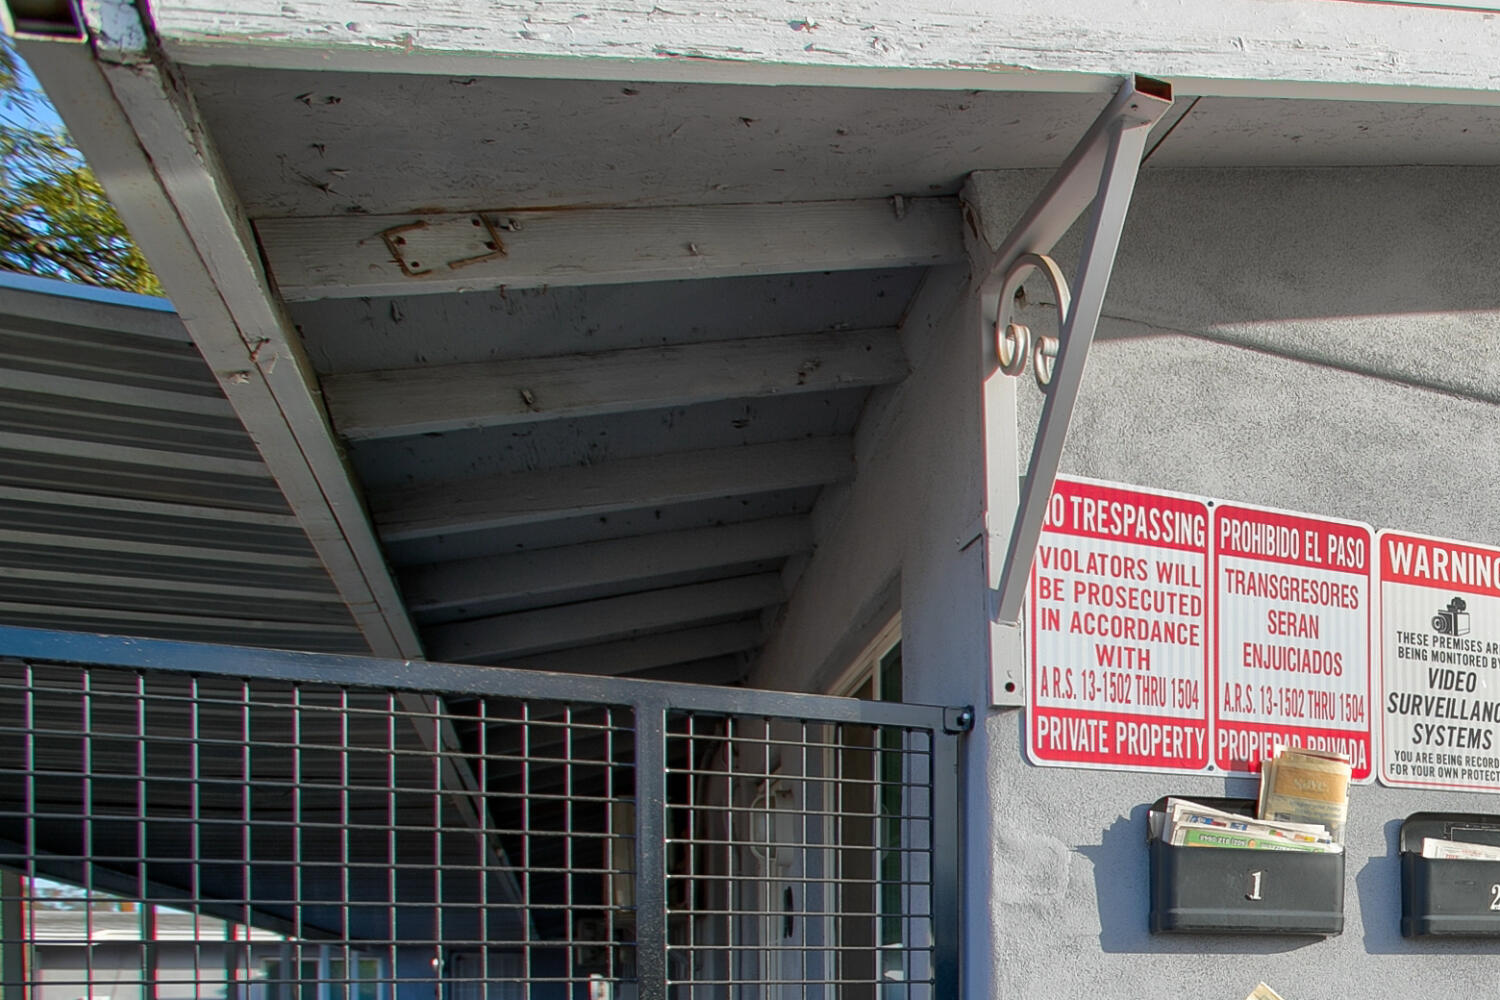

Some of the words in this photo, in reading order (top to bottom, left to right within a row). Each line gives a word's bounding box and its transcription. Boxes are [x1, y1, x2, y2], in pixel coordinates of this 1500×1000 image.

[1070, 495, 1205, 548] TRESPASSING
[1220, 517, 1300, 560] PROHIBIDO
[1305, 531, 1322, 563] EL
[1328, 534, 1364, 569] PASO
[1039, 545, 1148, 581] VIOLATORS
[1156, 560, 1202, 588] WILL
[1039, 576, 1064, 601] BE
[1074, 580, 1202, 617] PROSECUTED
[1225, 568, 1359, 610] TRANSGRESORES
[1041, 607, 1060, 632] IN
[1069, 611, 1200, 646] ACCORDANCE
[1267, 609, 1319, 639] SERAN
[1397, 630, 1429, 646] THESE
[1432, 635, 1483, 653] PREMISES
[1095, 643, 1150, 671] WITH
[1243, 642, 1343, 677] ENJUICIADOS
[1398, 646, 1428, 661] BEING
[1431, 650, 1488, 668] MONITORED
[1081, 669, 1131, 704] 13-1502
[1135, 675, 1166, 707] THRU
[1171, 677, 1199, 710] 1504
[1428, 667, 1477, 693] VIDEO
[1224, 682, 1256, 714] A.R.S.
[1260, 685, 1304, 718] 13-1502
[1308, 690, 1335, 720] THRU
[1339, 693, 1364, 722] 1504
[1037, 715, 1109, 753] PRIVATE
[1116, 721, 1205, 760] PROPERTY
[1412, 723, 1493, 750] SYSTEMS
[1390, 763, 1408, 775] FOR
[1410, 764, 1435, 777] YOUR
[1437, 766, 1459, 779] OWN
[1394, 750, 1413, 762] YOU
[1415, 752, 1433, 764] ARE
[1436, 753, 1462, 766] BEING
[1249, 871, 1264, 900] 1
